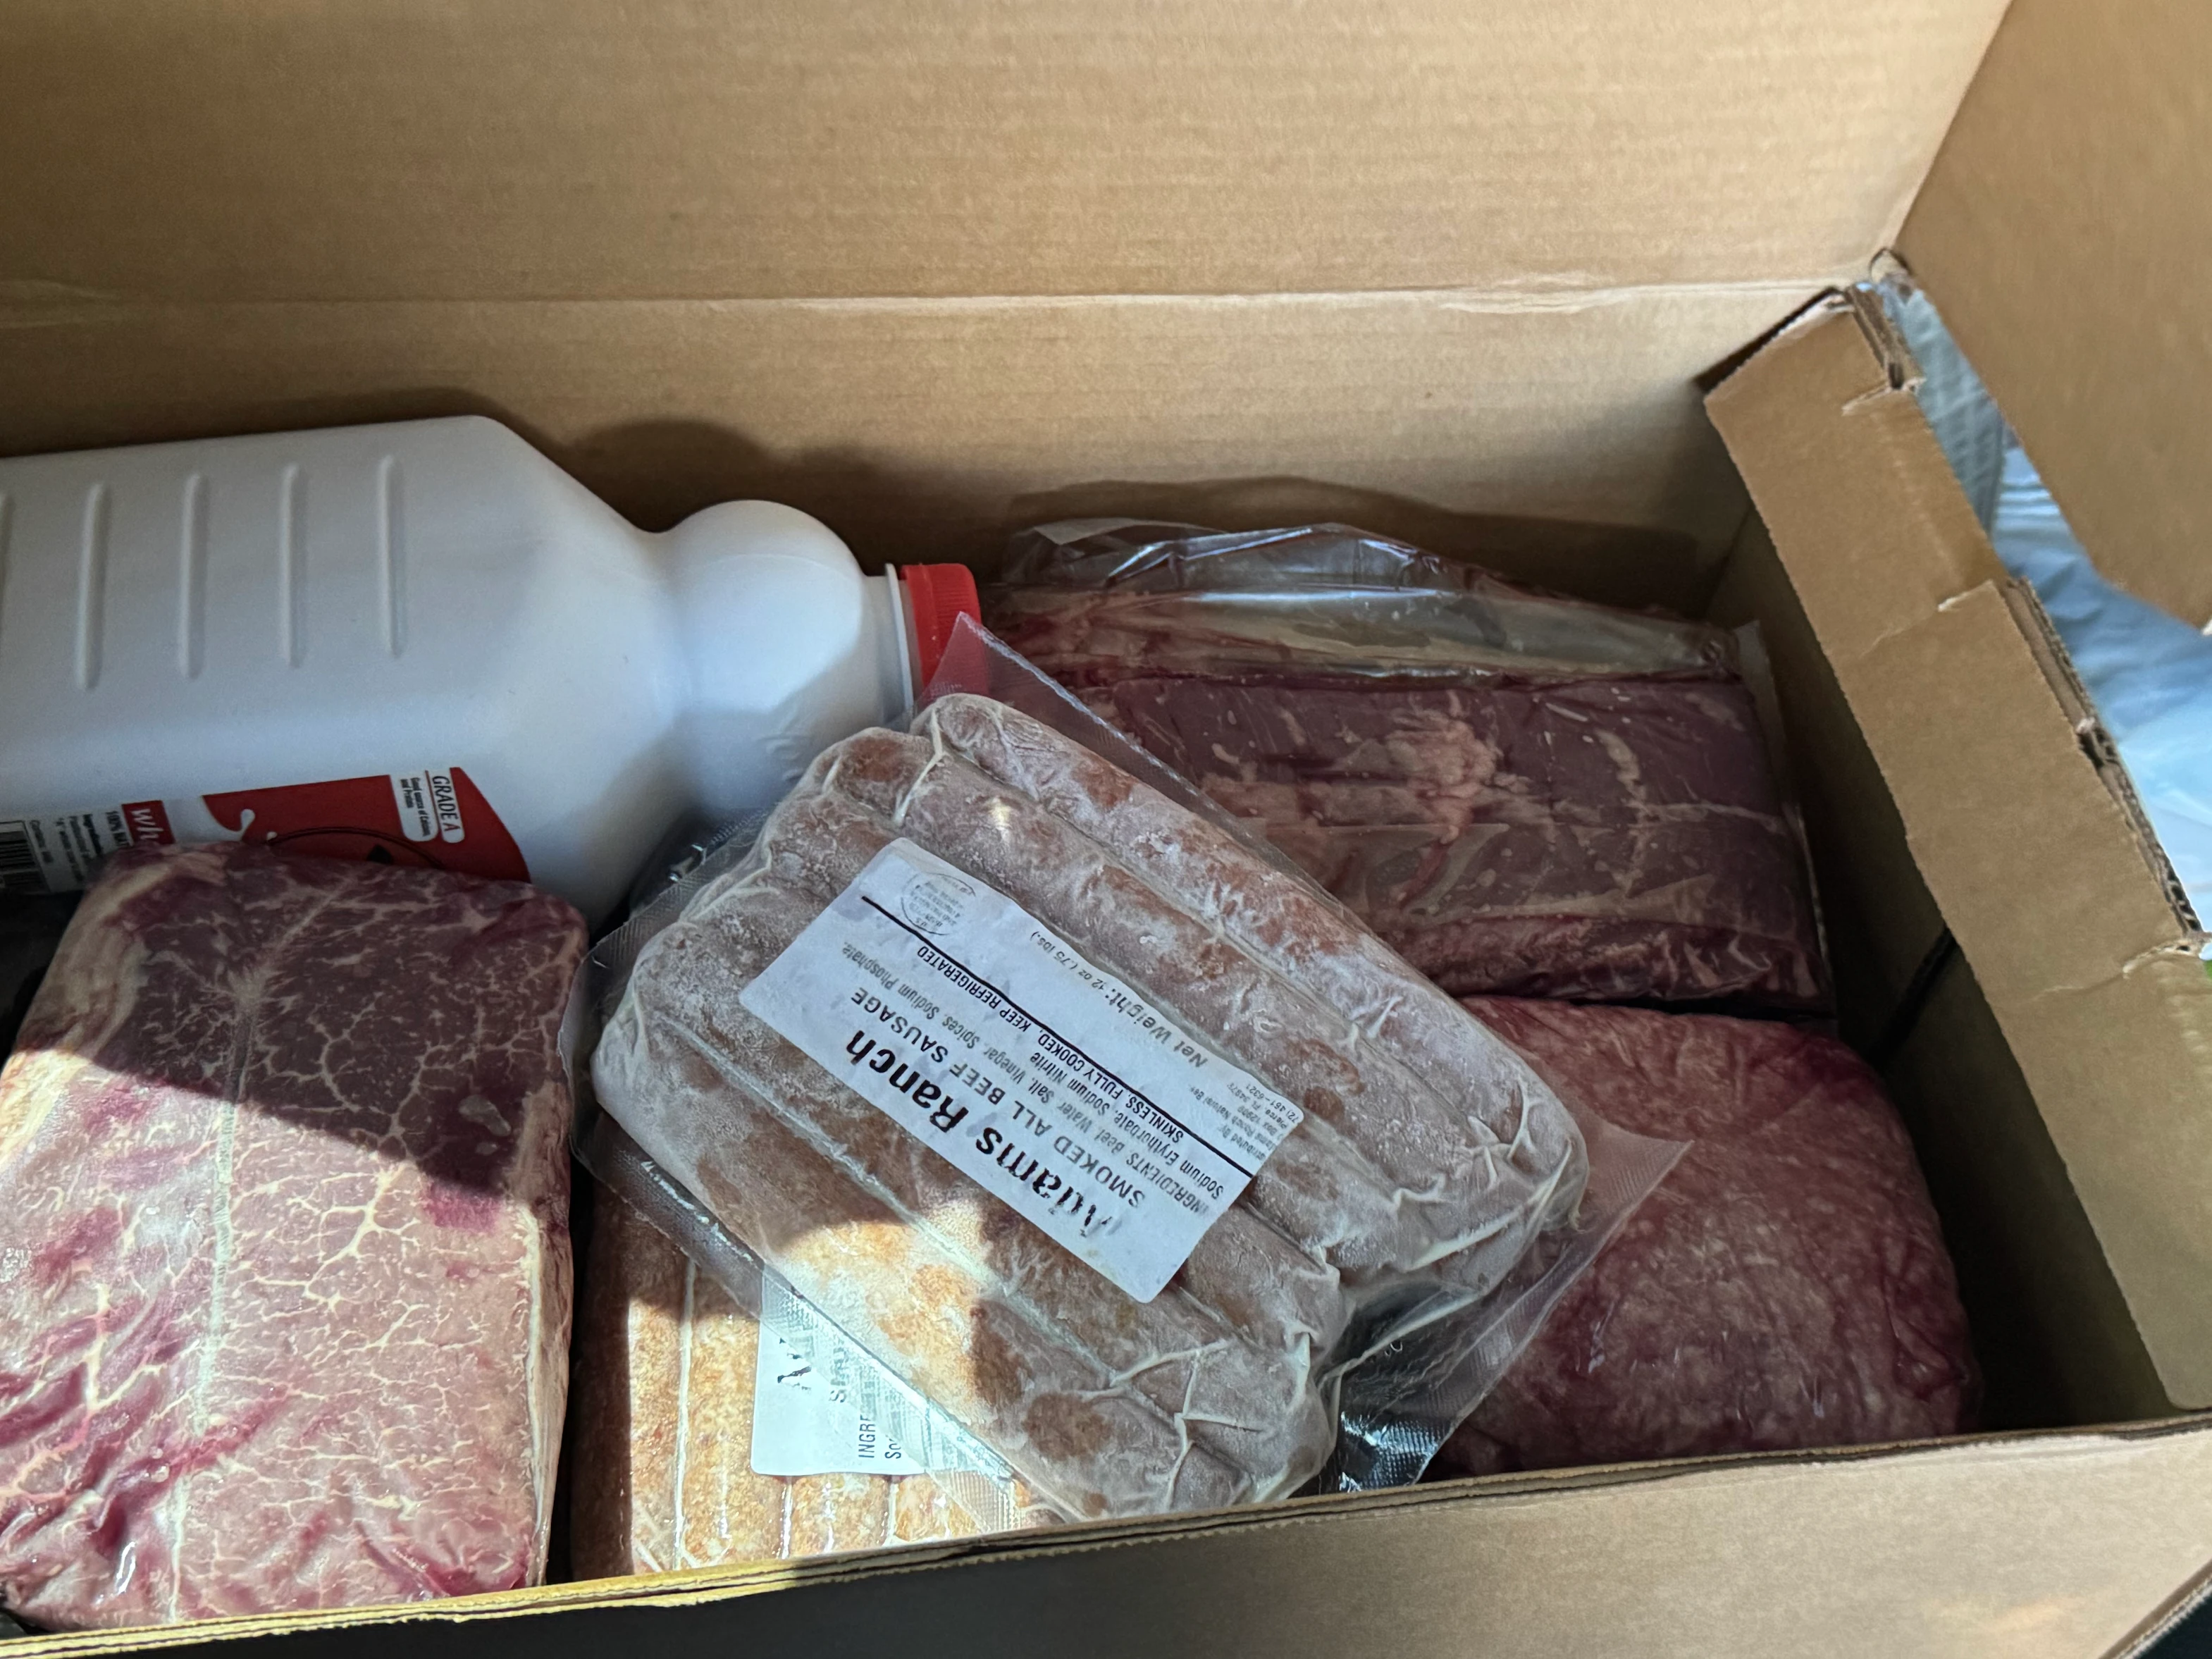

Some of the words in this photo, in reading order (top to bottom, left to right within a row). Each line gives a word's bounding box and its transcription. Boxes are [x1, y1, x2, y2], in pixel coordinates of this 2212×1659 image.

[432, 776, 458, 820] GRADE
[444, 822, 460, 832] A
[915, 944, 1001, 1011] REFRIGERATED
[1077, 968, 1092, 981] oz
[1091, 977, 1106, 992] 12
[895, 982, 941, 1021] Sodium
[998, 1004, 1032, 1033] KEEP
[1102, 987, 1172, 1044] Weight:
[850, 985, 950, 1065] SAUSAGE
[1027, 1050, 1068, 1087] Nitrite
[1172, 1038, 1208, 1070] Net
[842, 1028, 969, 1137] Ranch
[948, 1057, 1006, 1106] BEEF
[1064, 1077, 1111, 1117] Sodium
[1082, 1065, 1123, 1100] FULLY
[1006, 1099, 1052, 1140] ALL
[1051, 1133, 1147, 1209] SMOKED
[1177, 1159, 1225, 1200] Sodium
